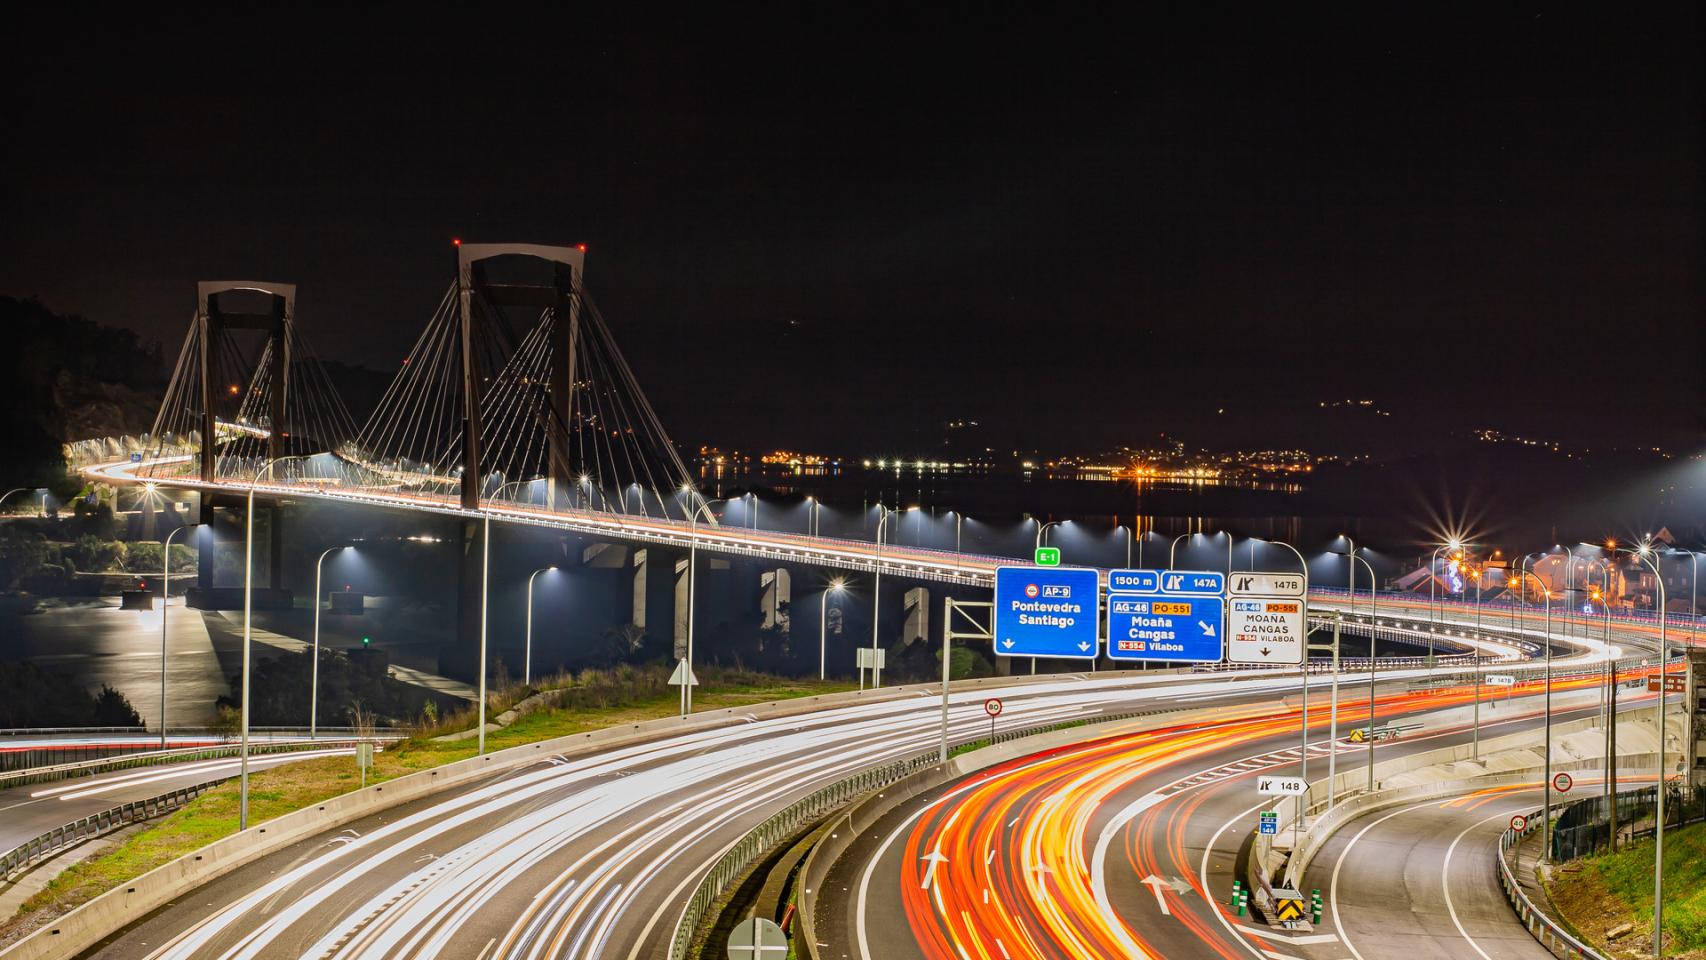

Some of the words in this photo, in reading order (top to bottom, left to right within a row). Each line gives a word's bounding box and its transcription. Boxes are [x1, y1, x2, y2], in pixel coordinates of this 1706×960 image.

[1040, 553, 1055, 561] E-1
[1115, 576, 1139, 585] 1500
[1143, 578, 1152, 586] m
[1194, 579, 1217, 588] 147A
[1274, 581, 1298, 589] 147B
[1045, 587, 1069, 596] AP-9
[1012, 601, 1081, 613] Pontevedra
[1115, 603, 1147, 612] AG-46
[1154, 604, 1190, 613] PO-551
[1019, 614, 1075, 628] Santiago
[1131, 617, 1172, 628] Moaña
[1246, 613, 1286, 623] MOAÑA
[1243, 624, 1288, 633] CANGAS
[1129, 628, 1175, 641] Cangas
[1149, 643, 1184, 651] Vilaboa
[1281, 782, 1300, 790] 148
